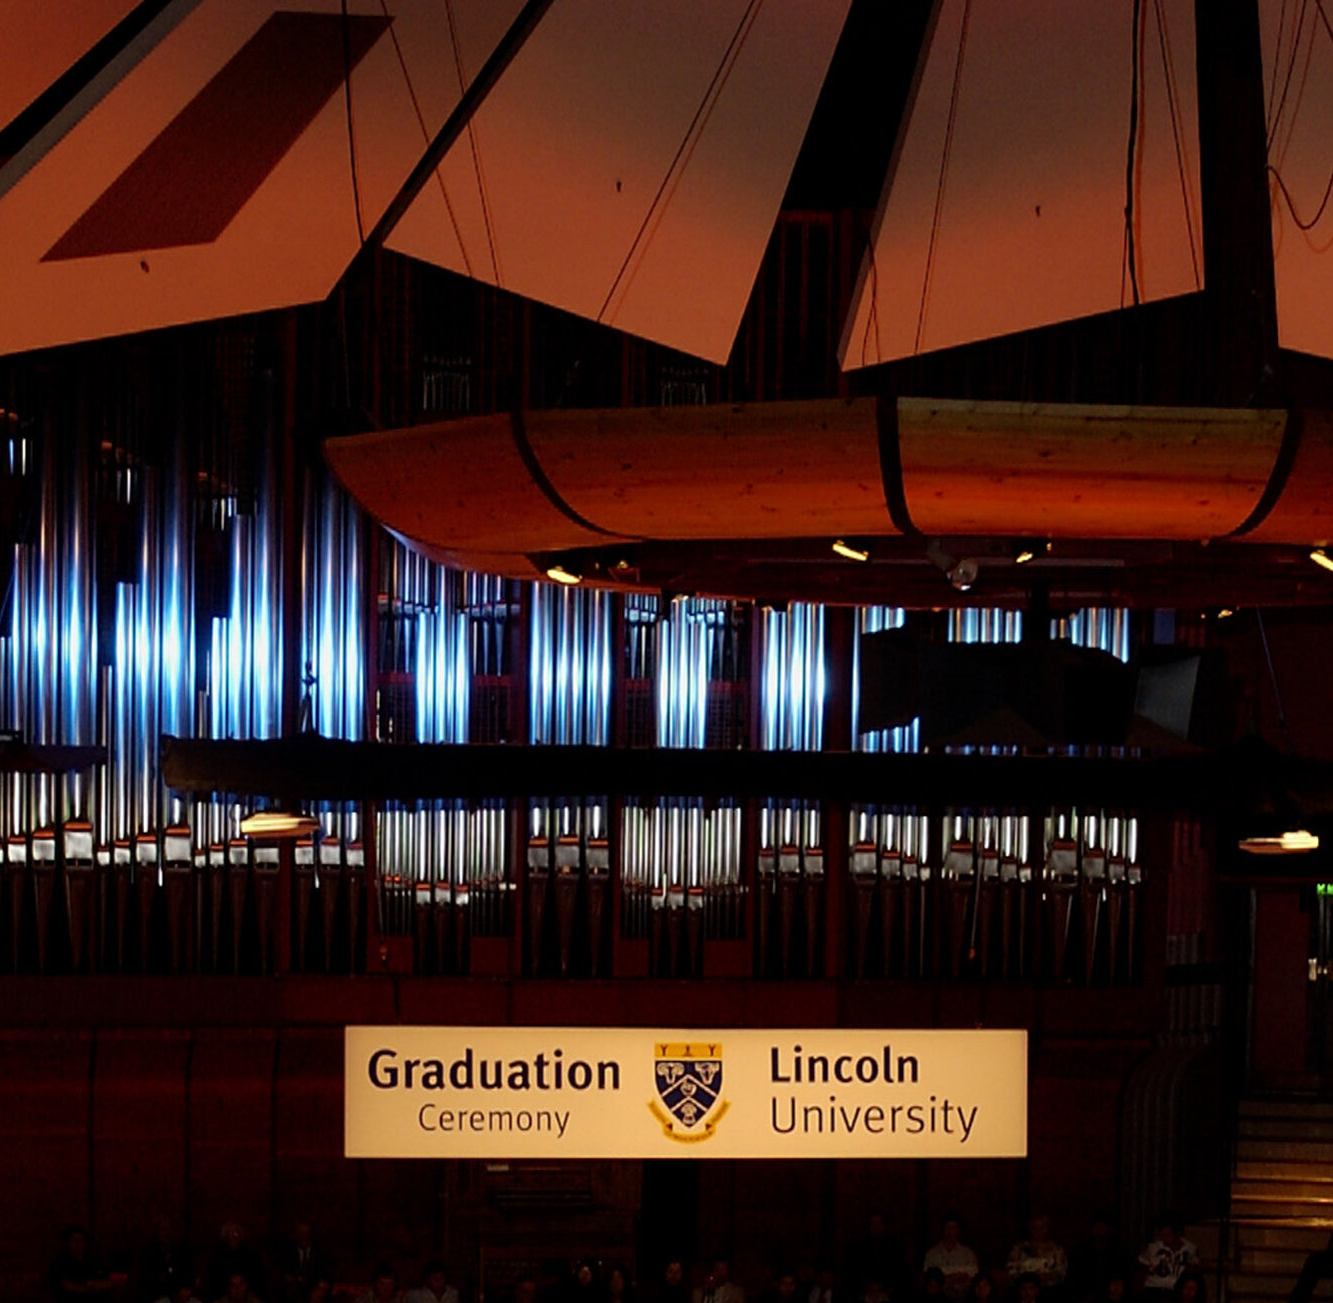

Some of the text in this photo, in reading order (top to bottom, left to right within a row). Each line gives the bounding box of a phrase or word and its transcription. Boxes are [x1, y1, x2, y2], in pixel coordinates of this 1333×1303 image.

[368, 1049, 620, 1090] Graduation
[771, 1045, 919, 1083] Lincoln
[418, 1103, 570, 1138] Ceremony
[771, 1096, 978, 1143] University
